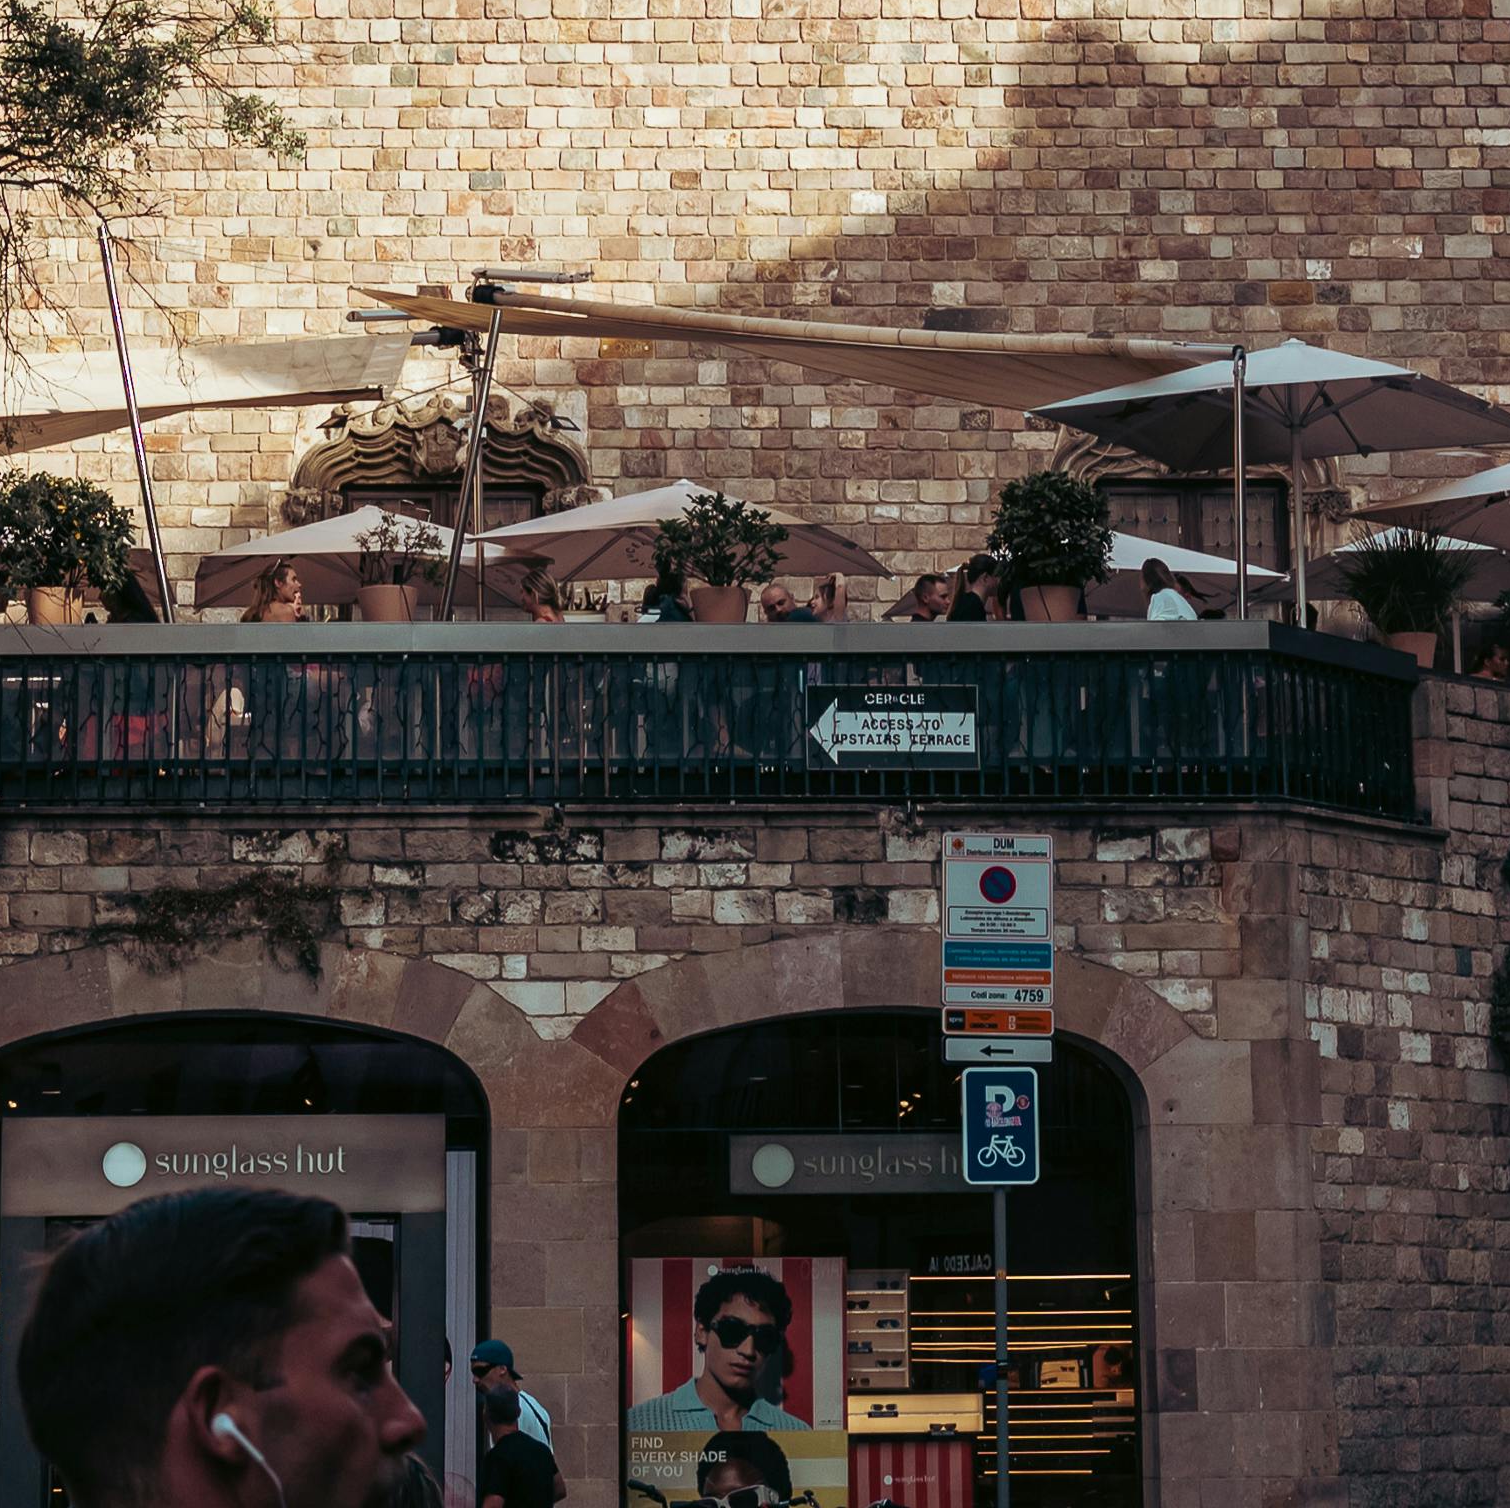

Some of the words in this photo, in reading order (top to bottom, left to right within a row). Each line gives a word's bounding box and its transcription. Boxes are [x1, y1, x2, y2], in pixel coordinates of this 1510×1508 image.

[861, 719, 914, 731] ACCESS
[924, 719, 941, 731] TO
[831, 733, 901, 745] UPSTAIRS
[911, 733, 970, 746] TERRACE
[993, 837, 1015, 849] DUM
[970, 991, 987, 1000] Codi
[1014, 989, 1044, 1003] 4759
[155, 1143, 289, 1180] sunglass
[296, 1143, 347, 1174] hut
[803, 1145, 933, 1184] sunglass
[631, 1436, 664, 1449] FIND
[631, 1451, 676, 1463] EVERY
[680, 1450, 727, 1463] SHADE
[631, 1465, 650, 1477] OF
[654, 1465, 683, 1477] YOU
